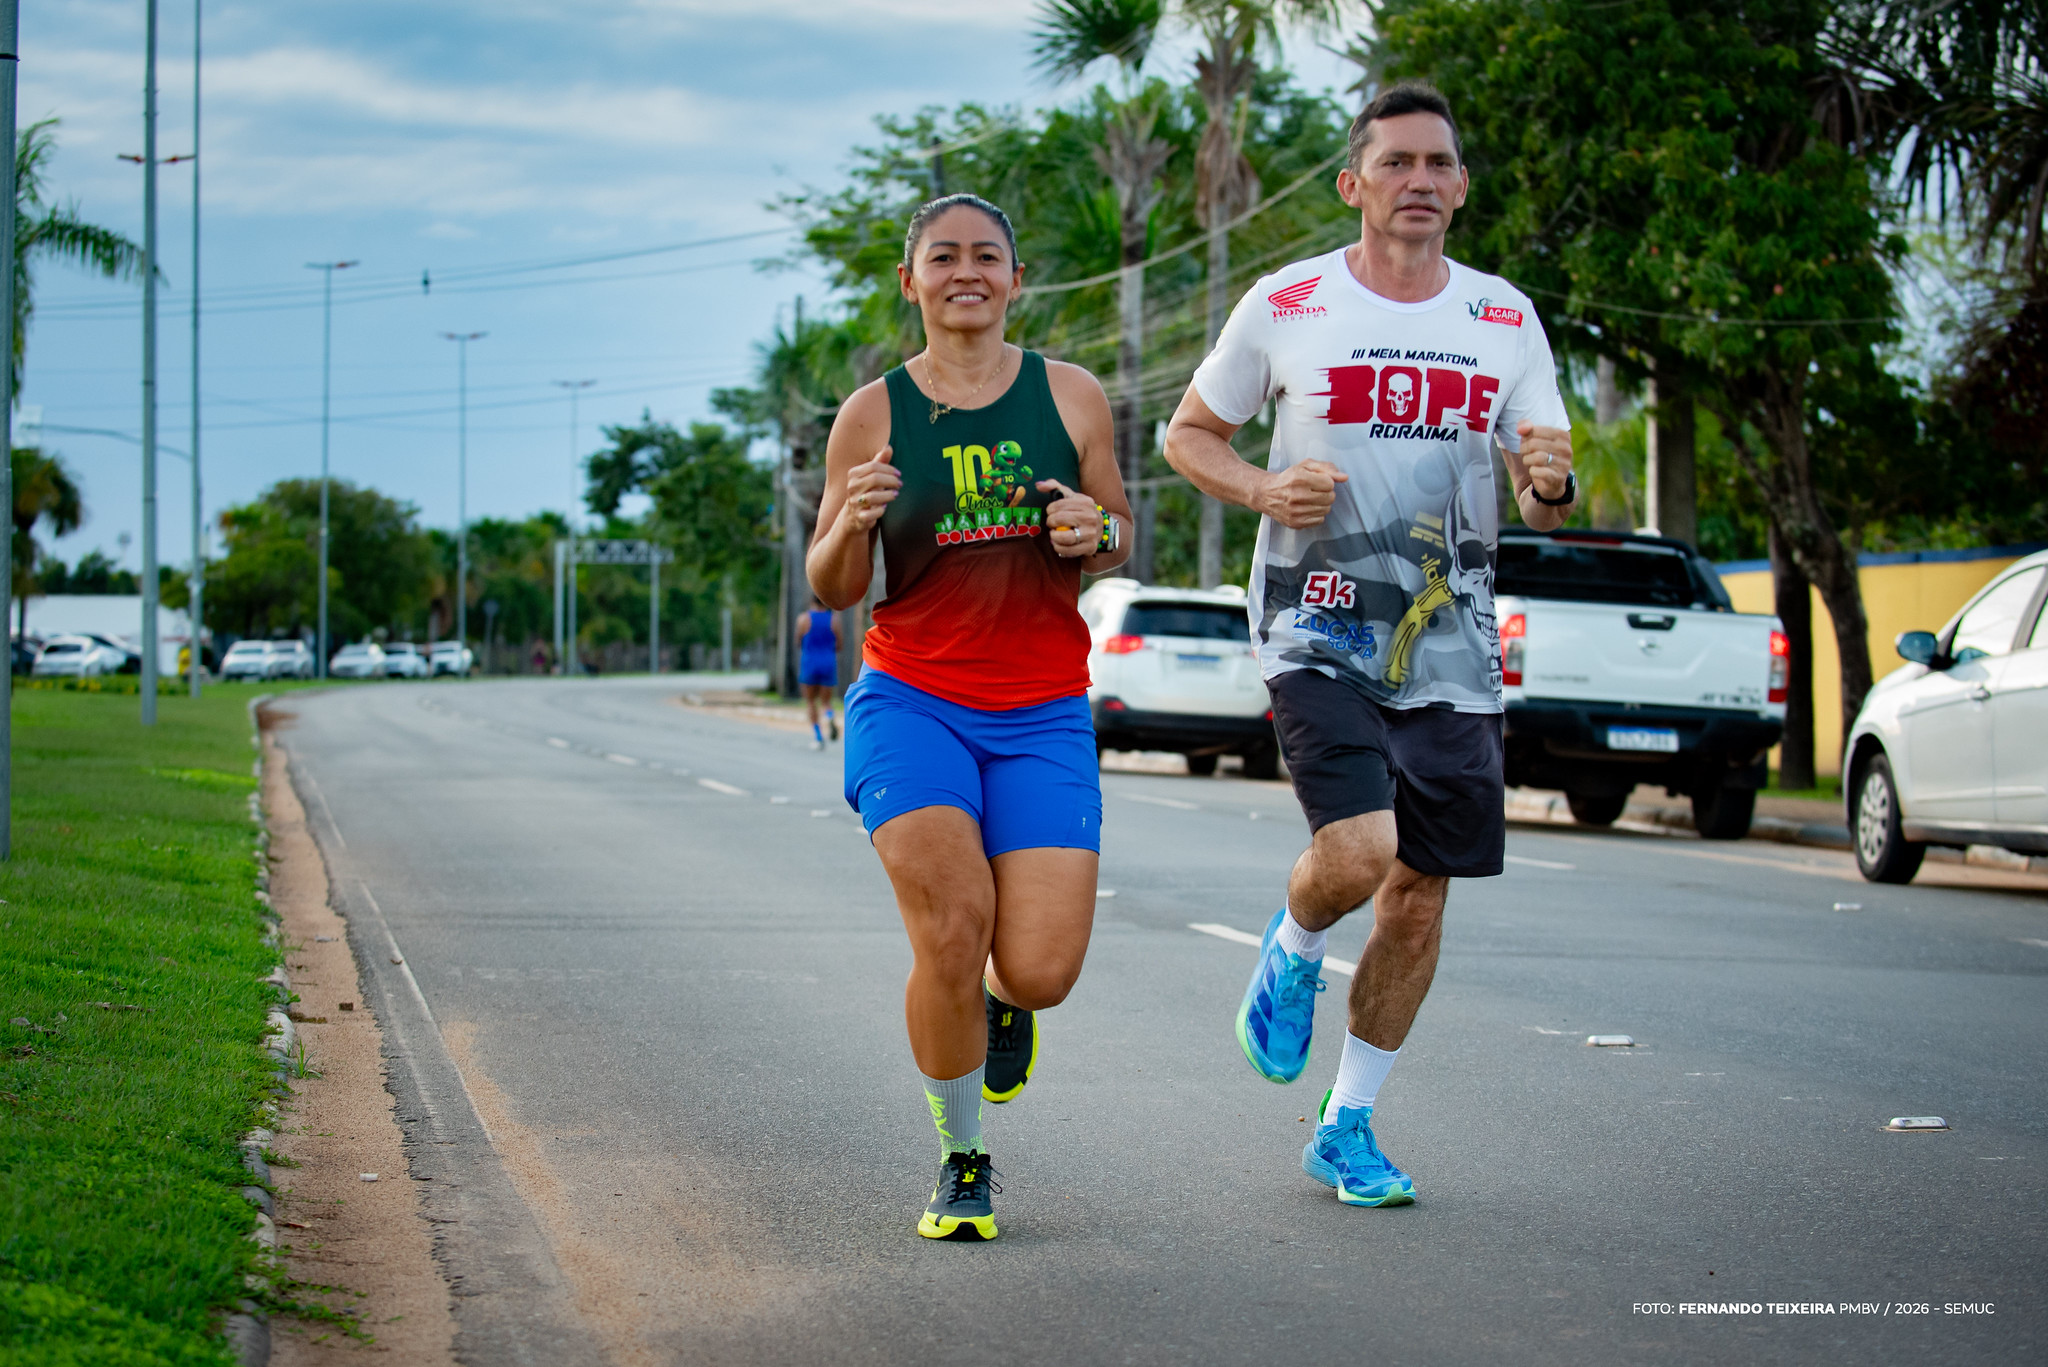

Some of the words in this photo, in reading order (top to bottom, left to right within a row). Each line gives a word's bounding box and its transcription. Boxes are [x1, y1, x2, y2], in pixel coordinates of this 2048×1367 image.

[1272, 306, 1327, 318] HONDA
[1351, 349, 1365, 360] III
[1368, 349, 1402, 360] MEIA
[1404, 350, 1478, 368] MARATONA
[1306, 365, 1500, 433] BOPE
[1369, 423, 1460, 443] RORAIMA
[942, 444, 992, 508] 10
[1004, 475, 1015, 484] 10
[955, 490, 1005, 514] Anos
[934, 507, 1042, 533] JABUTI
[936, 529, 962, 546] DO
[963, 524, 1042, 543] LAVRADO
[1293, 613, 1375, 645] LUCAS
